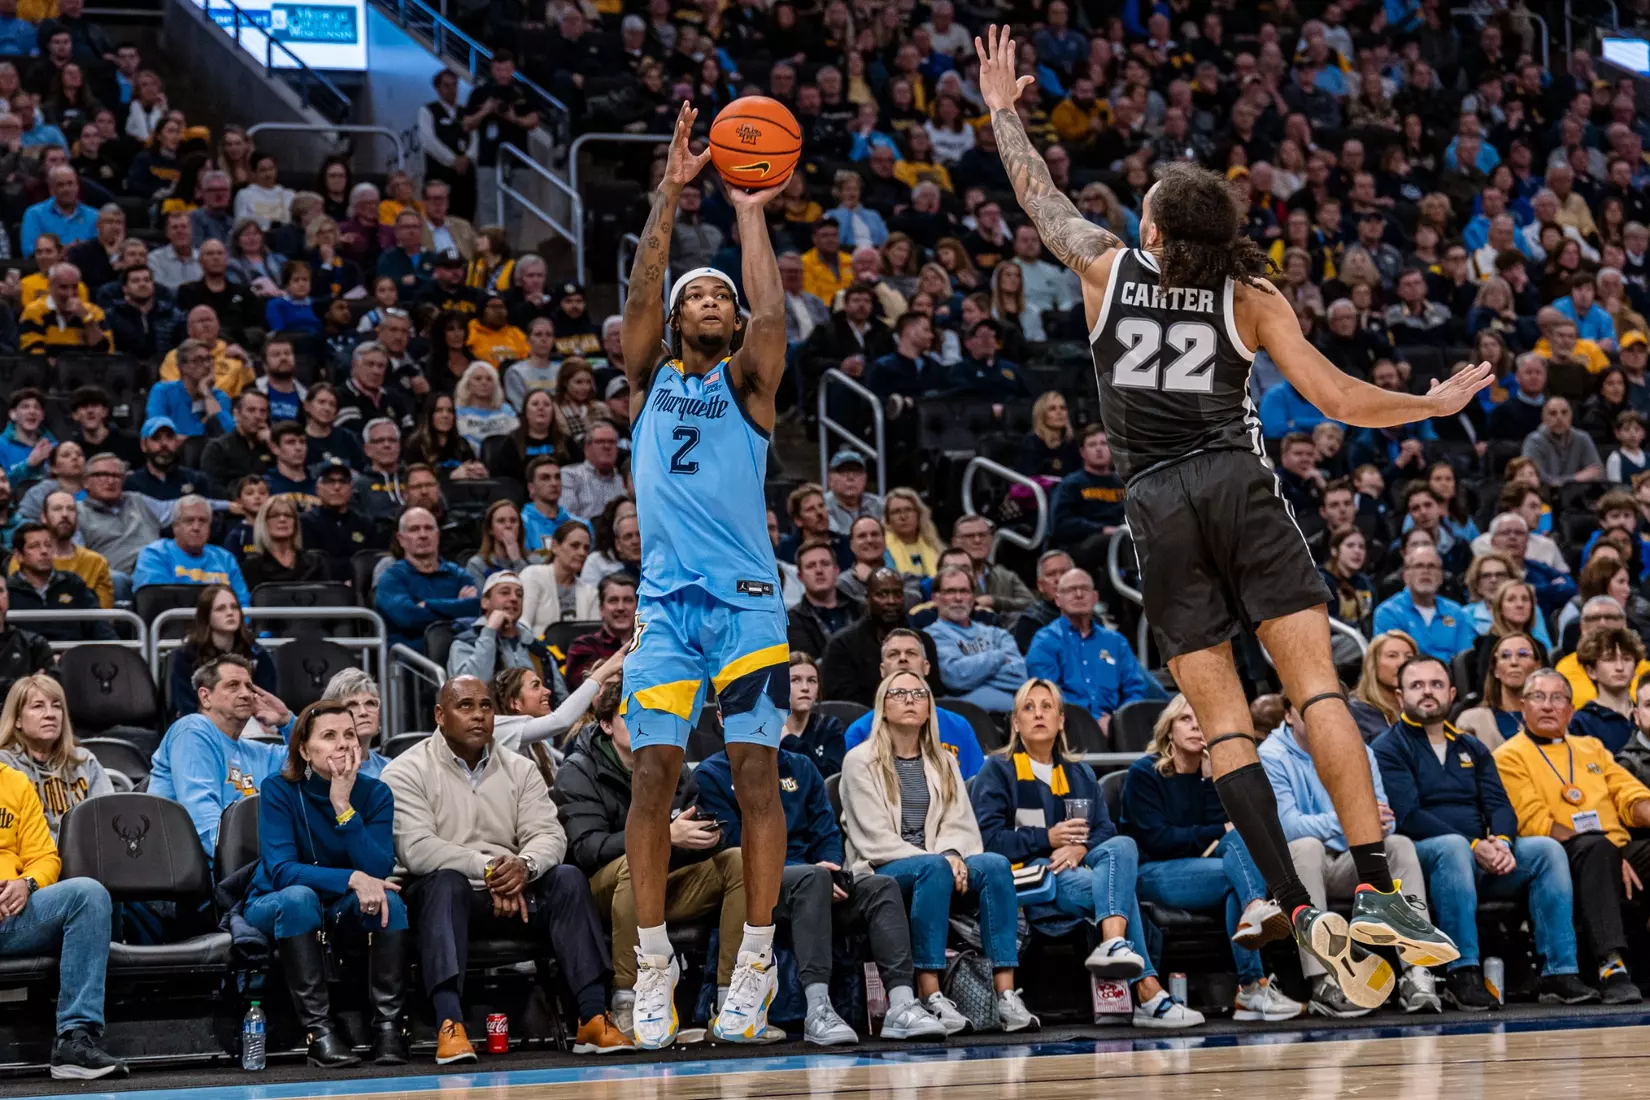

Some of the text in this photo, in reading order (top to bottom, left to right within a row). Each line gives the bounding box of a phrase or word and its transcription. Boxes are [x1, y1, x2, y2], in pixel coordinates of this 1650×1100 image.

[1121, 281, 1214, 313] CARTER
[1112, 317, 1217, 394] 22
[651, 388, 729, 421] Marquette
[669, 425, 701, 475] 2
